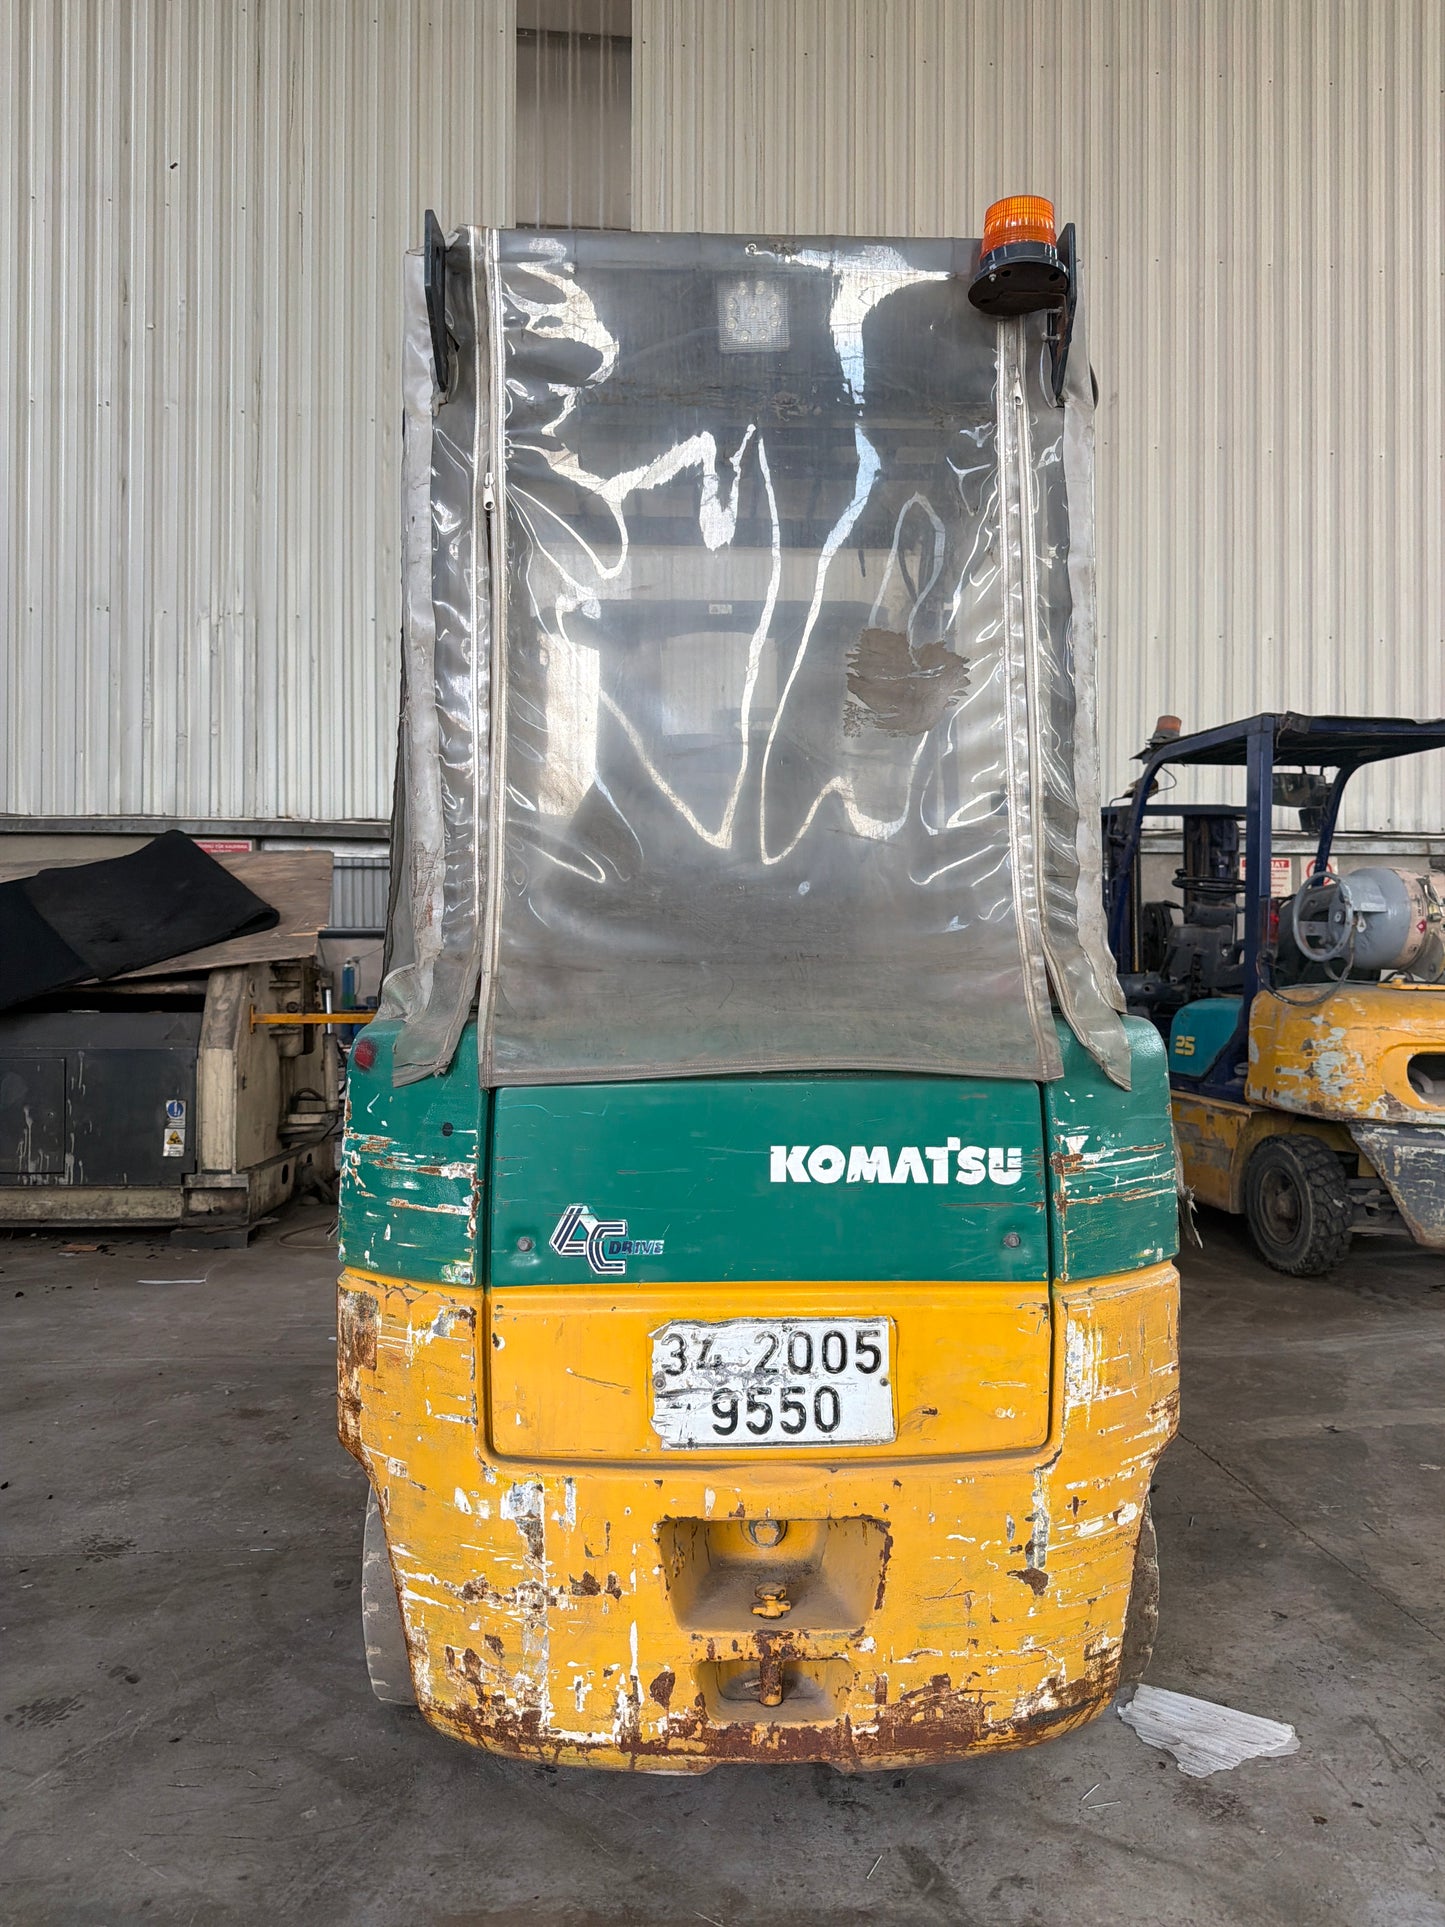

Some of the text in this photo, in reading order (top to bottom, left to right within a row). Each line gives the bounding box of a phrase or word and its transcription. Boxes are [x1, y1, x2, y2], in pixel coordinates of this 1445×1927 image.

[1175, 1035, 1195, 1056] 25
[770, 1137, 1022, 1185] KOMATSU
[608, 1239, 665, 1255] DRIVE
[754, 1329, 882, 1376] 2005
[711, 1385, 841, 1436] 9550
